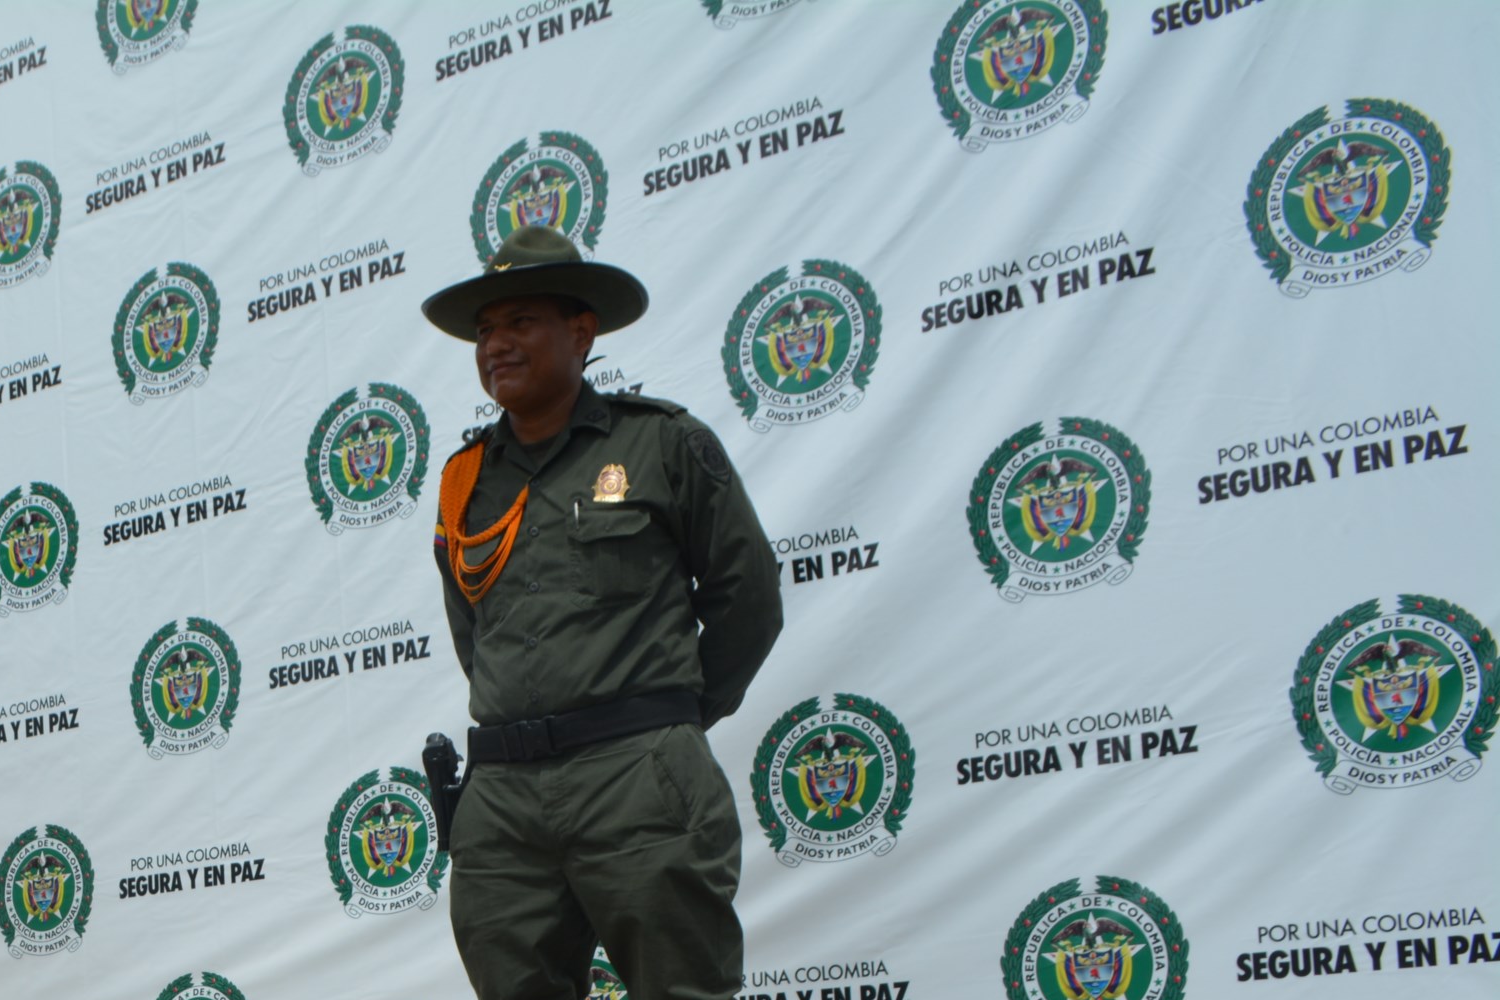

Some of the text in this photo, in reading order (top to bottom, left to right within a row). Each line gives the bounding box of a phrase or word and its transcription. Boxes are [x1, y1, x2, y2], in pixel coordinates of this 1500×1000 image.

[96, 130, 212, 186] POR UNA COLOMBIA
[642, 108, 846, 197] SEGURA Y EN PAZ
[658, 96, 823, 162] POR UNA COLOMBIA
[1330, 121, 1352, 134] DE
[1370, 122, 1425, 185] COLOMBIA
[85, 142, 226, 215] SEGURA Y EN PAZ
[1353, 203, 1420, 262] NACIONAL
[247, 250, 406, 324] SEGURA Y EN PAZ
[259, 238, 390, 293] POR UNA COLOMBIA
[921, 246, 1156, 334] SEGURA Y EN PAZ
[939, 230, 1130, 297] POR UNA COLOMBIA
[1303, 270, 1339, 284] DIOS
[1355, 249, 1407, 279] PATRIA
[1197, 424, 1469, 505] SEGURA Y EN PAZ
[1217, 405, 1440, 466] POR UNA COLOMBIA
[268, 634, 431, 690] SEGURA Y EN PAZ
[281, 619, 414, 660] POR UNA COLOMBIA
[1382, 617, 1404, 629] DE
[1422, 621, 1477, 692] COLOMBIA
[956, 724, 1199, 786] SEGURA Y EN PAZ
[975, 704, 1174, 750] POR UNA COLOMBIA
[1402, 710, 1472, 764] NACIONAL
[1348, 767, 1385, 783] DIOS
[1403, 755, 1457, 783] PATRIA
[1257, 906, 1486, 944] POR UNA COLOMBIA
[752, 970, 791, 987] UNA
[795, 960, 888, 983] COLOMBIA
[1236, 931, 1500, 983] SEGURA Y EN PAZ
